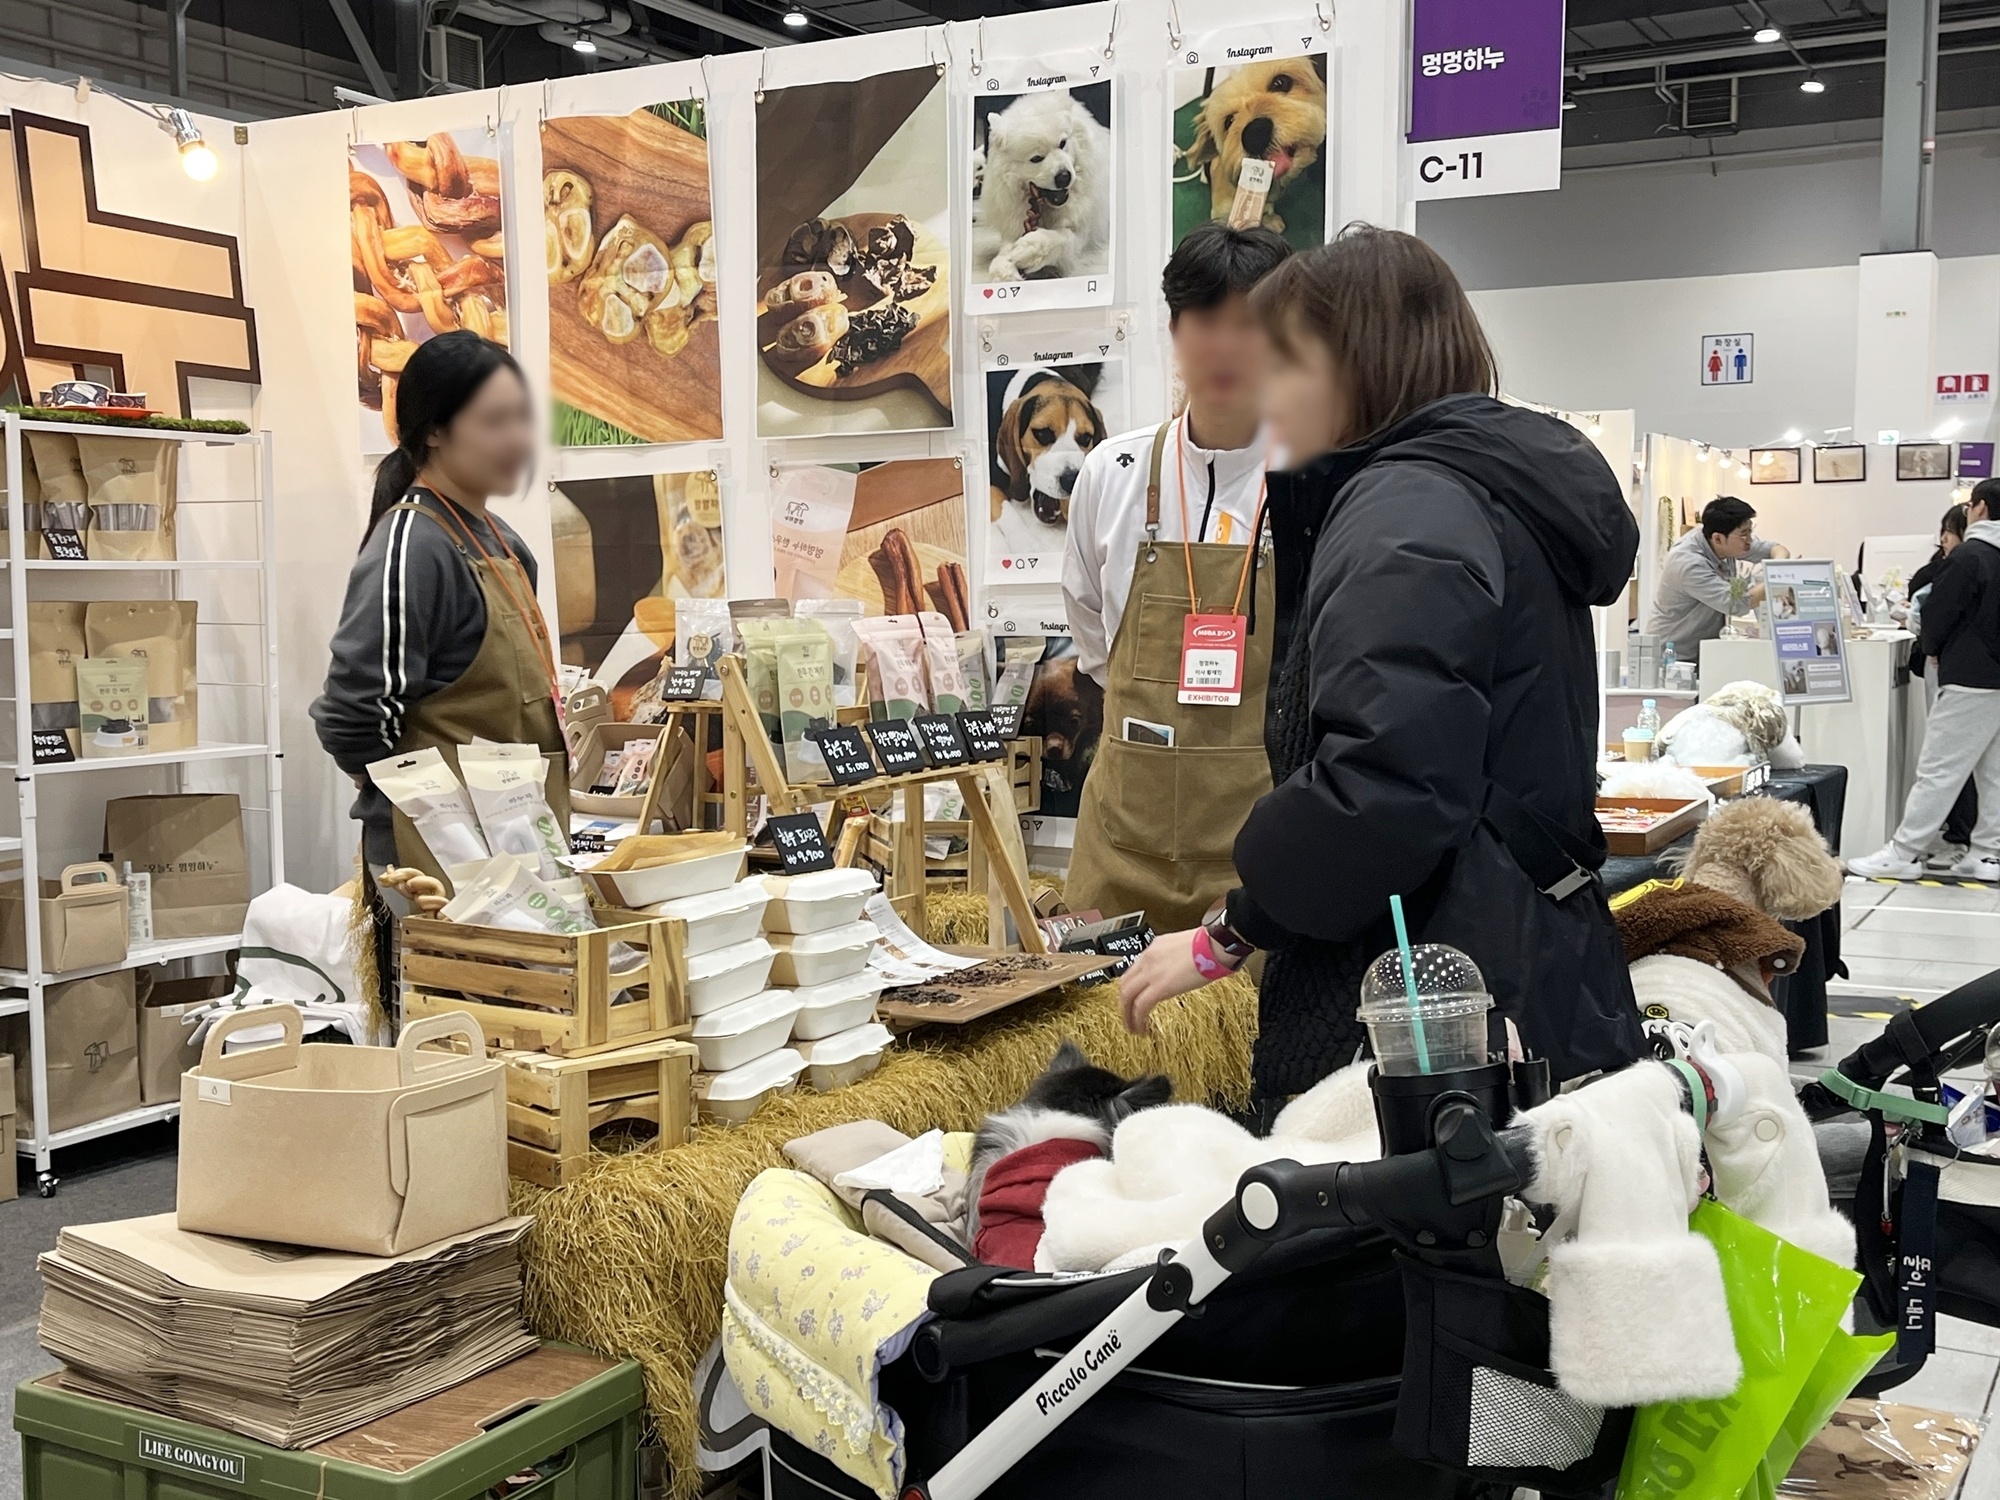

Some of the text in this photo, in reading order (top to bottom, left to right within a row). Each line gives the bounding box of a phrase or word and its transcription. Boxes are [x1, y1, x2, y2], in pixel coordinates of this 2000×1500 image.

[1226, 45, 1273, 59] Instagram
[1422, 46, 1505, 77] 멍멍하누
[1026, 75, 1067, 87] Instagram
[1420, 151, 1483, 183] C-11
[1715, 338, 1741, 347] 화장실
[1033, 351, 1073, 363] Instagram
[1040, 621, 1070, 633] Instagr
[1187, 693, 1230, 702] EXHIBITOR
[823, 738, 858, 758] 한우 간
[776, 826, 798, 848] 한우
[1035, 1366, 1088, 1416] Piccolo
[145, 1438, 239, 1476] LIFE GONGYOU
